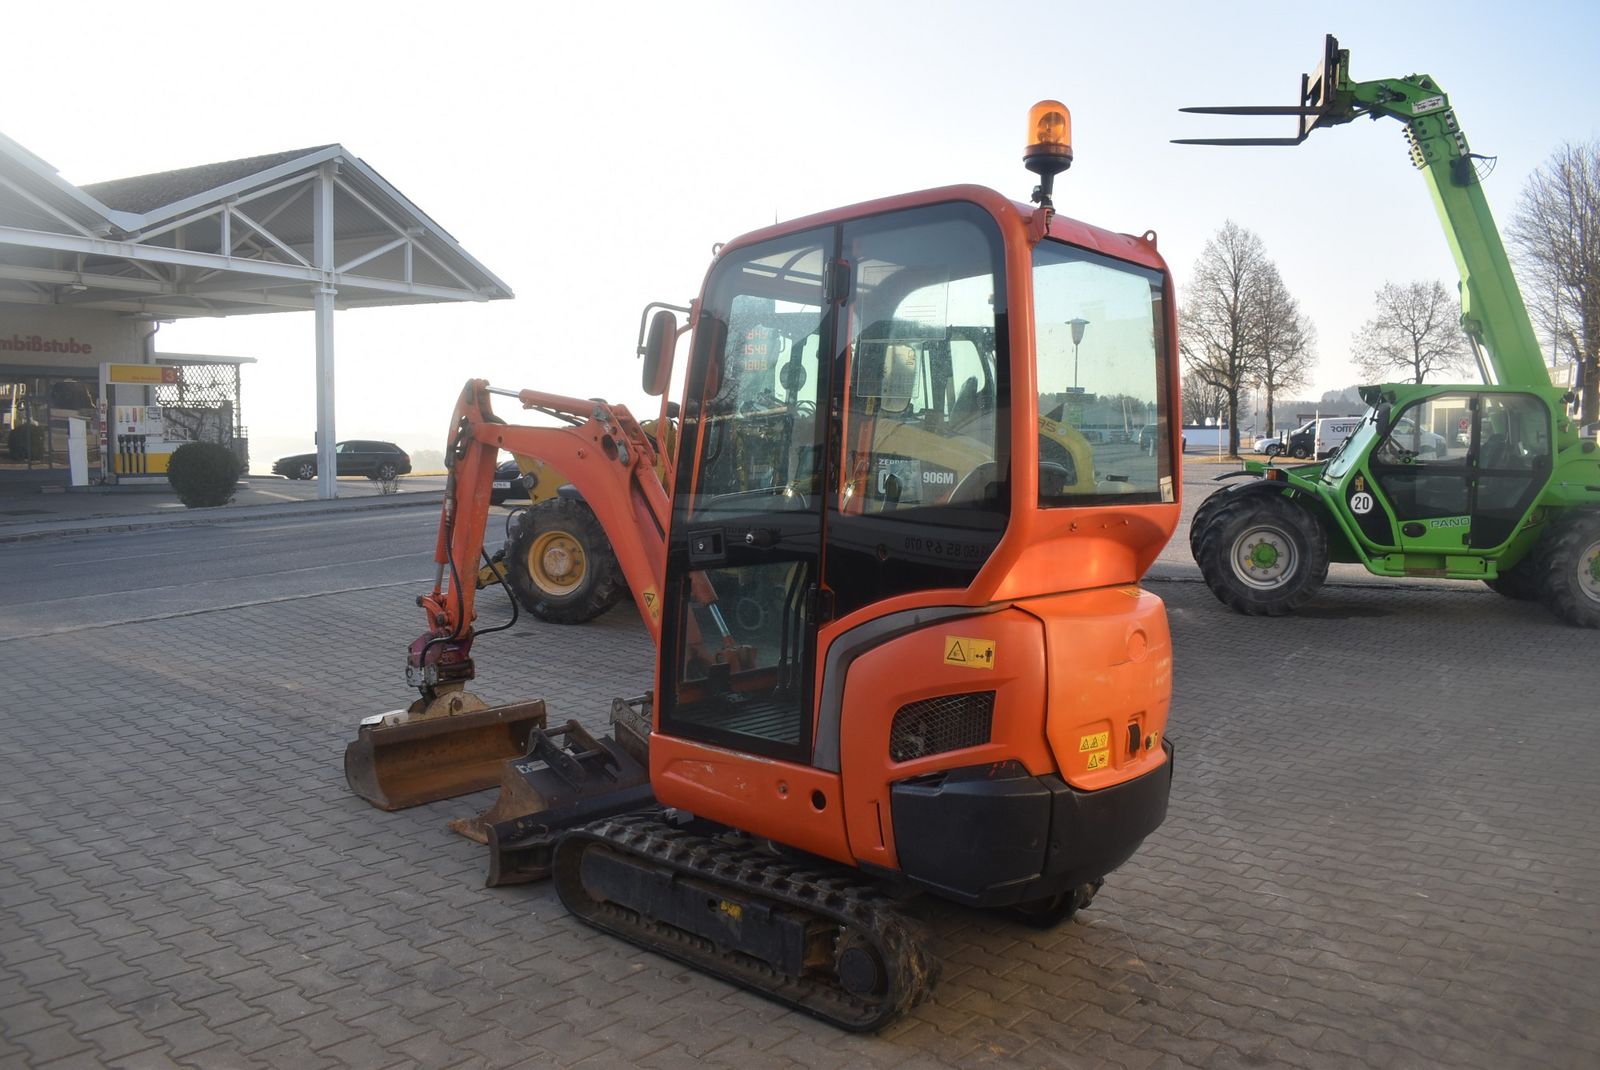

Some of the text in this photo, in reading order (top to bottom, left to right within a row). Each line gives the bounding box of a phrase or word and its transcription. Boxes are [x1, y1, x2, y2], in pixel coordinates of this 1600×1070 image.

[166, 369, 175, 382] 3
[923, 471, 954, 484] 906M
[1354, 496, 1370, 510] 20
